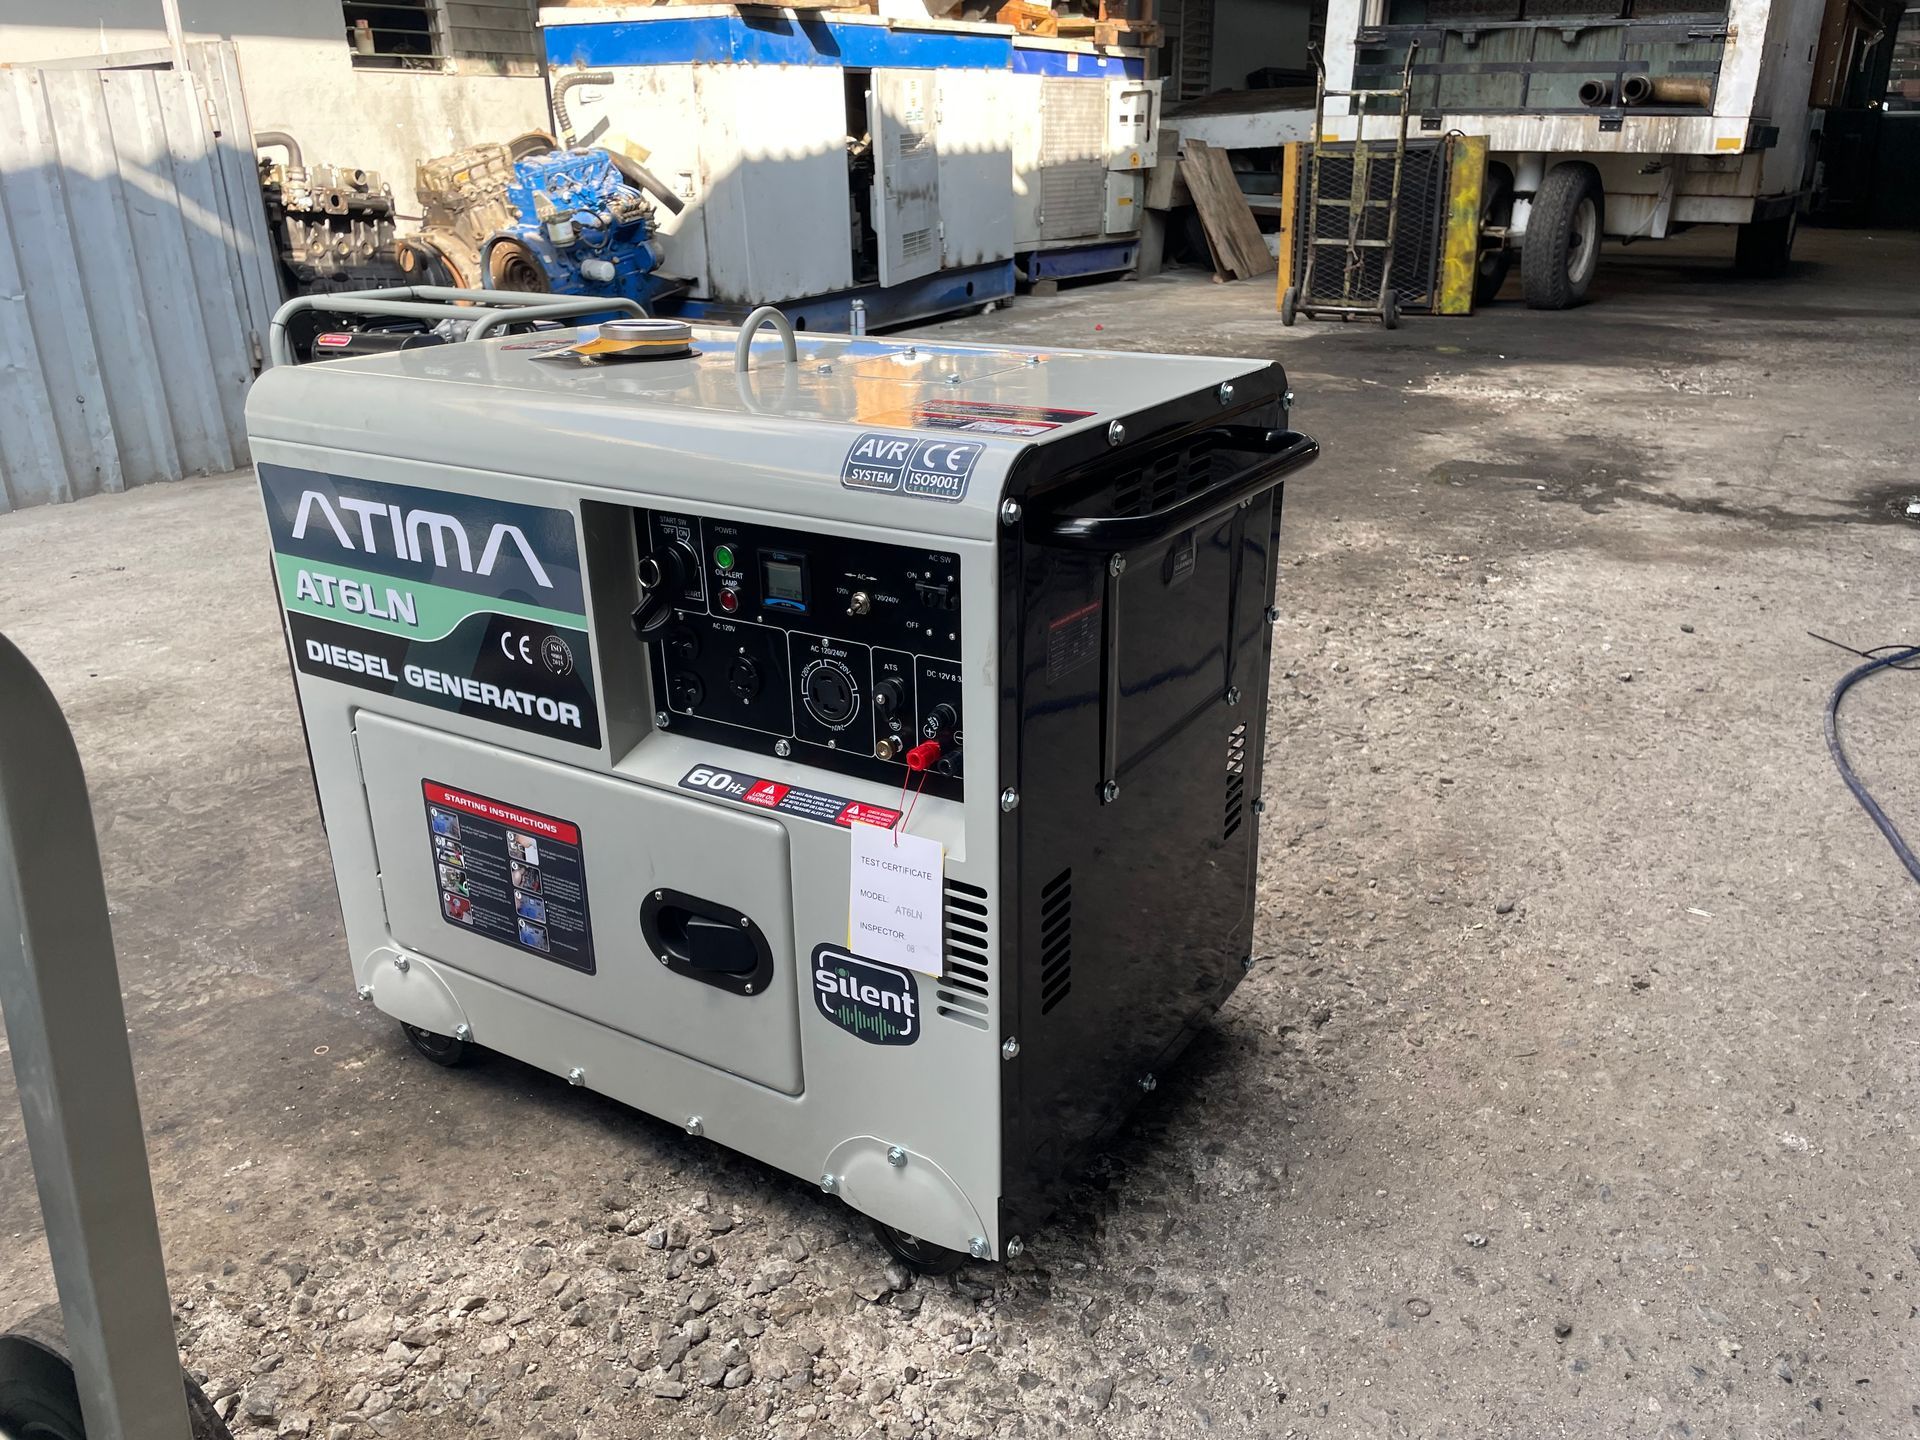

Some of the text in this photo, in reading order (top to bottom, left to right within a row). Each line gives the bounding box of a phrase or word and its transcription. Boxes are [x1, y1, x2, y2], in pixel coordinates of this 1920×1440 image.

[855, 438, 910, 461] AVR
[923, 444, 970, 471] CE
[851, 468, 894, 484] SYSTEM
[909, 472, 959, 490] ISO9001
[907, 485, 958, 496] CERTIFIED
[659, 516, 688, 526] START SW
[663, 527, 689, 538] OFF ON
[714, 525, 738, 535] POWER
[291, 490, 554, 589] ATIMA
[928, 553, 952, 564] AC SW
[725, 570, 744, 580] ALERT
[857, 573, 866, 581] AC
[907, 571, 918, 580] ON
[722, 578, 739, 588] LAMP
[296, 569, 418, 627] AT6LN
[874, 593, 901, 604] 120/240V
[713, 621, 736, 633] AC 120V
[906, 620, 918, 629] OFF
[500, 631, 534, 665] CE
[810, 644, 848, 659] AC 120/240V
[305, 639, 399, 683] DIESEL
[801, 664, 811, 678] 120V
[837, 661, 852, 675] 120V
[883, 663, 899, 673] ATS
[926, 669, 936, 678] DC
[938, 671, 950, 681] 12V
[403, 666, 582, 730] GENERATOR
[687, 768, 747, 795] 60Hz
[752, 791, 765, 799] LOW
[828, 798, 846, 806] WITHOUT
[444, 792, 488, 813] STARTING
[489, 806, 558, 834] INSTRUCTIONS
[792, 805, 810, 813] PRESSURE
[861, 856, 933, 881] TEST CERTIFICATE
[895, 905, 923, 920] AT6LN
[815, 967, 916, 1018] Silent
